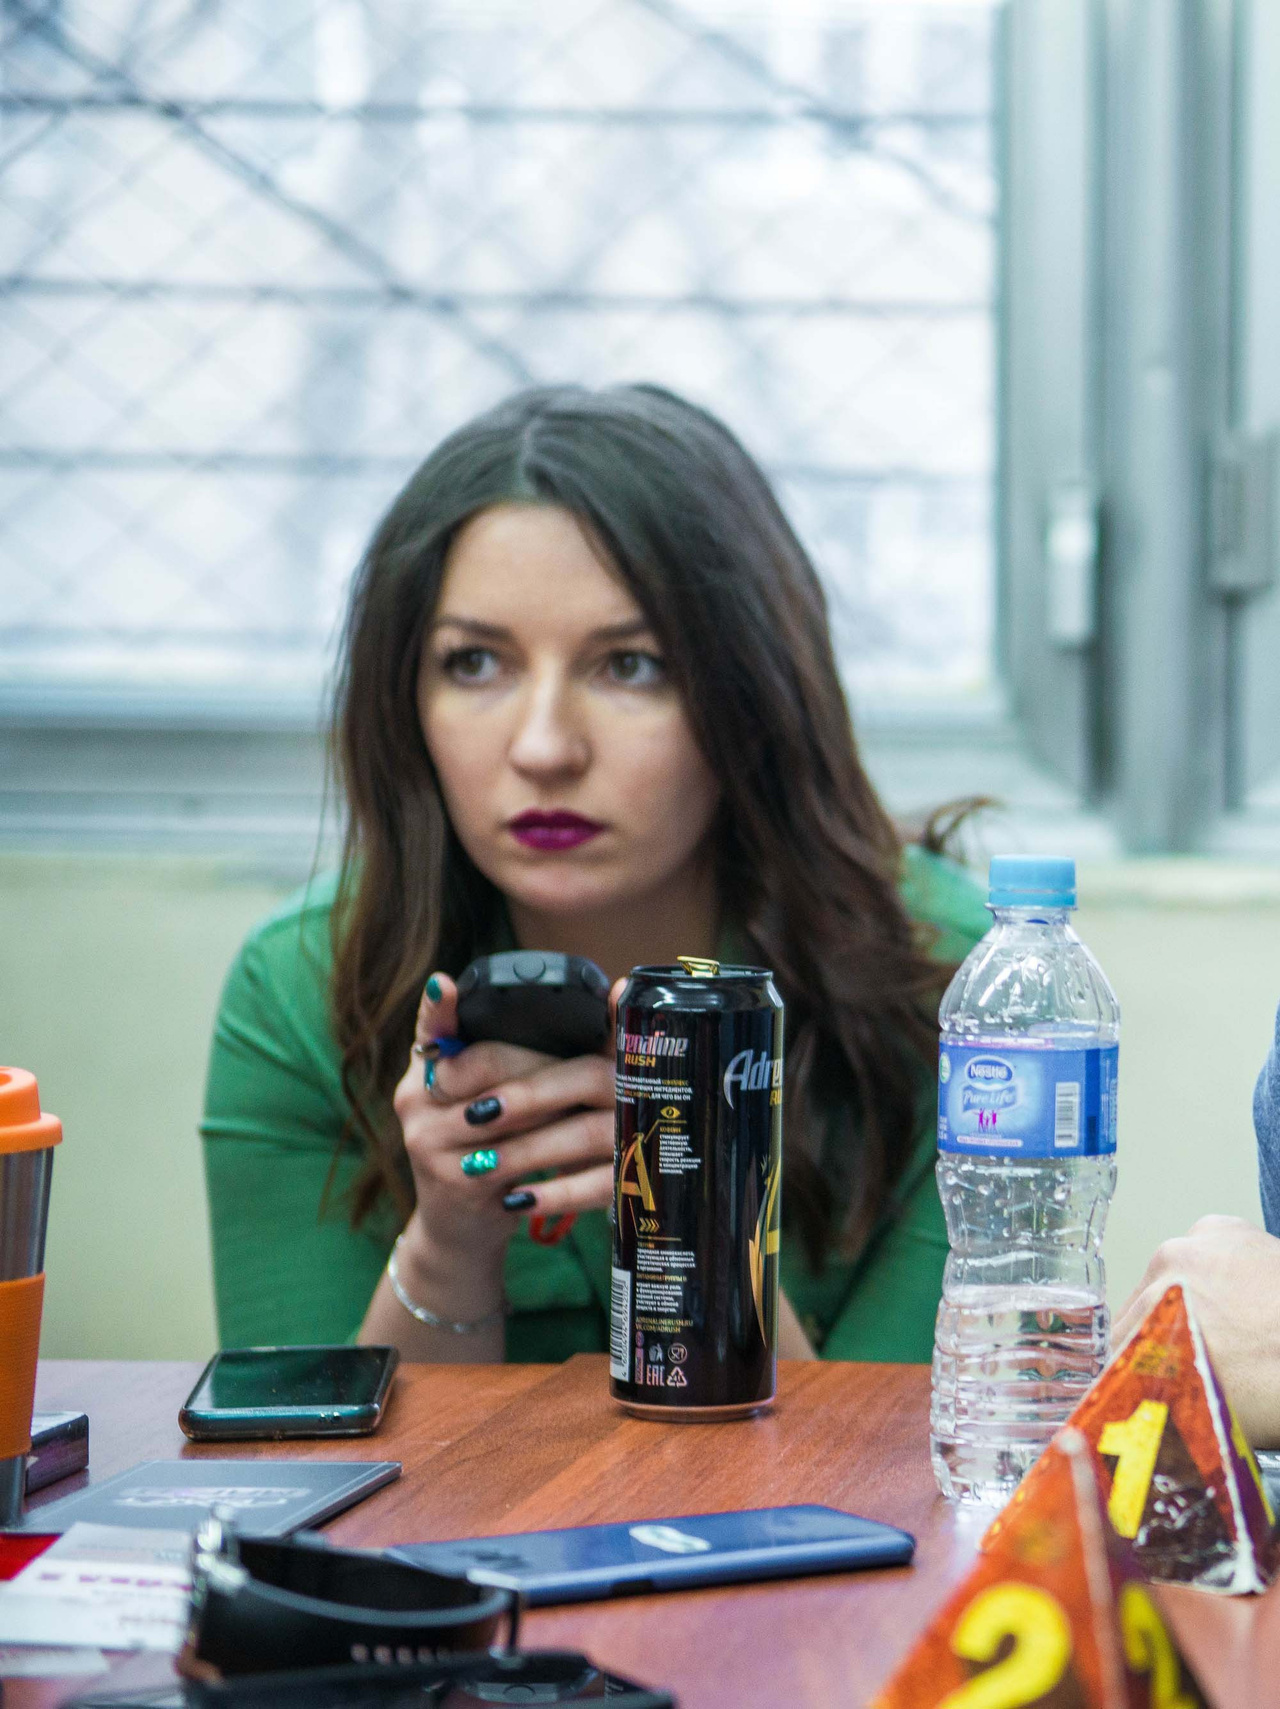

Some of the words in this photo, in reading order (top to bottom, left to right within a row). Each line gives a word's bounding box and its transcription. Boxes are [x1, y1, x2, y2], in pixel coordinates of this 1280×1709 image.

[616, 1026, 688, 1057] drenaline
[625, 1053, 656, 1068] RUSH
[1097, 1400, 1168, 1539] 1
[937, 1580, 1073, 1709] 2
